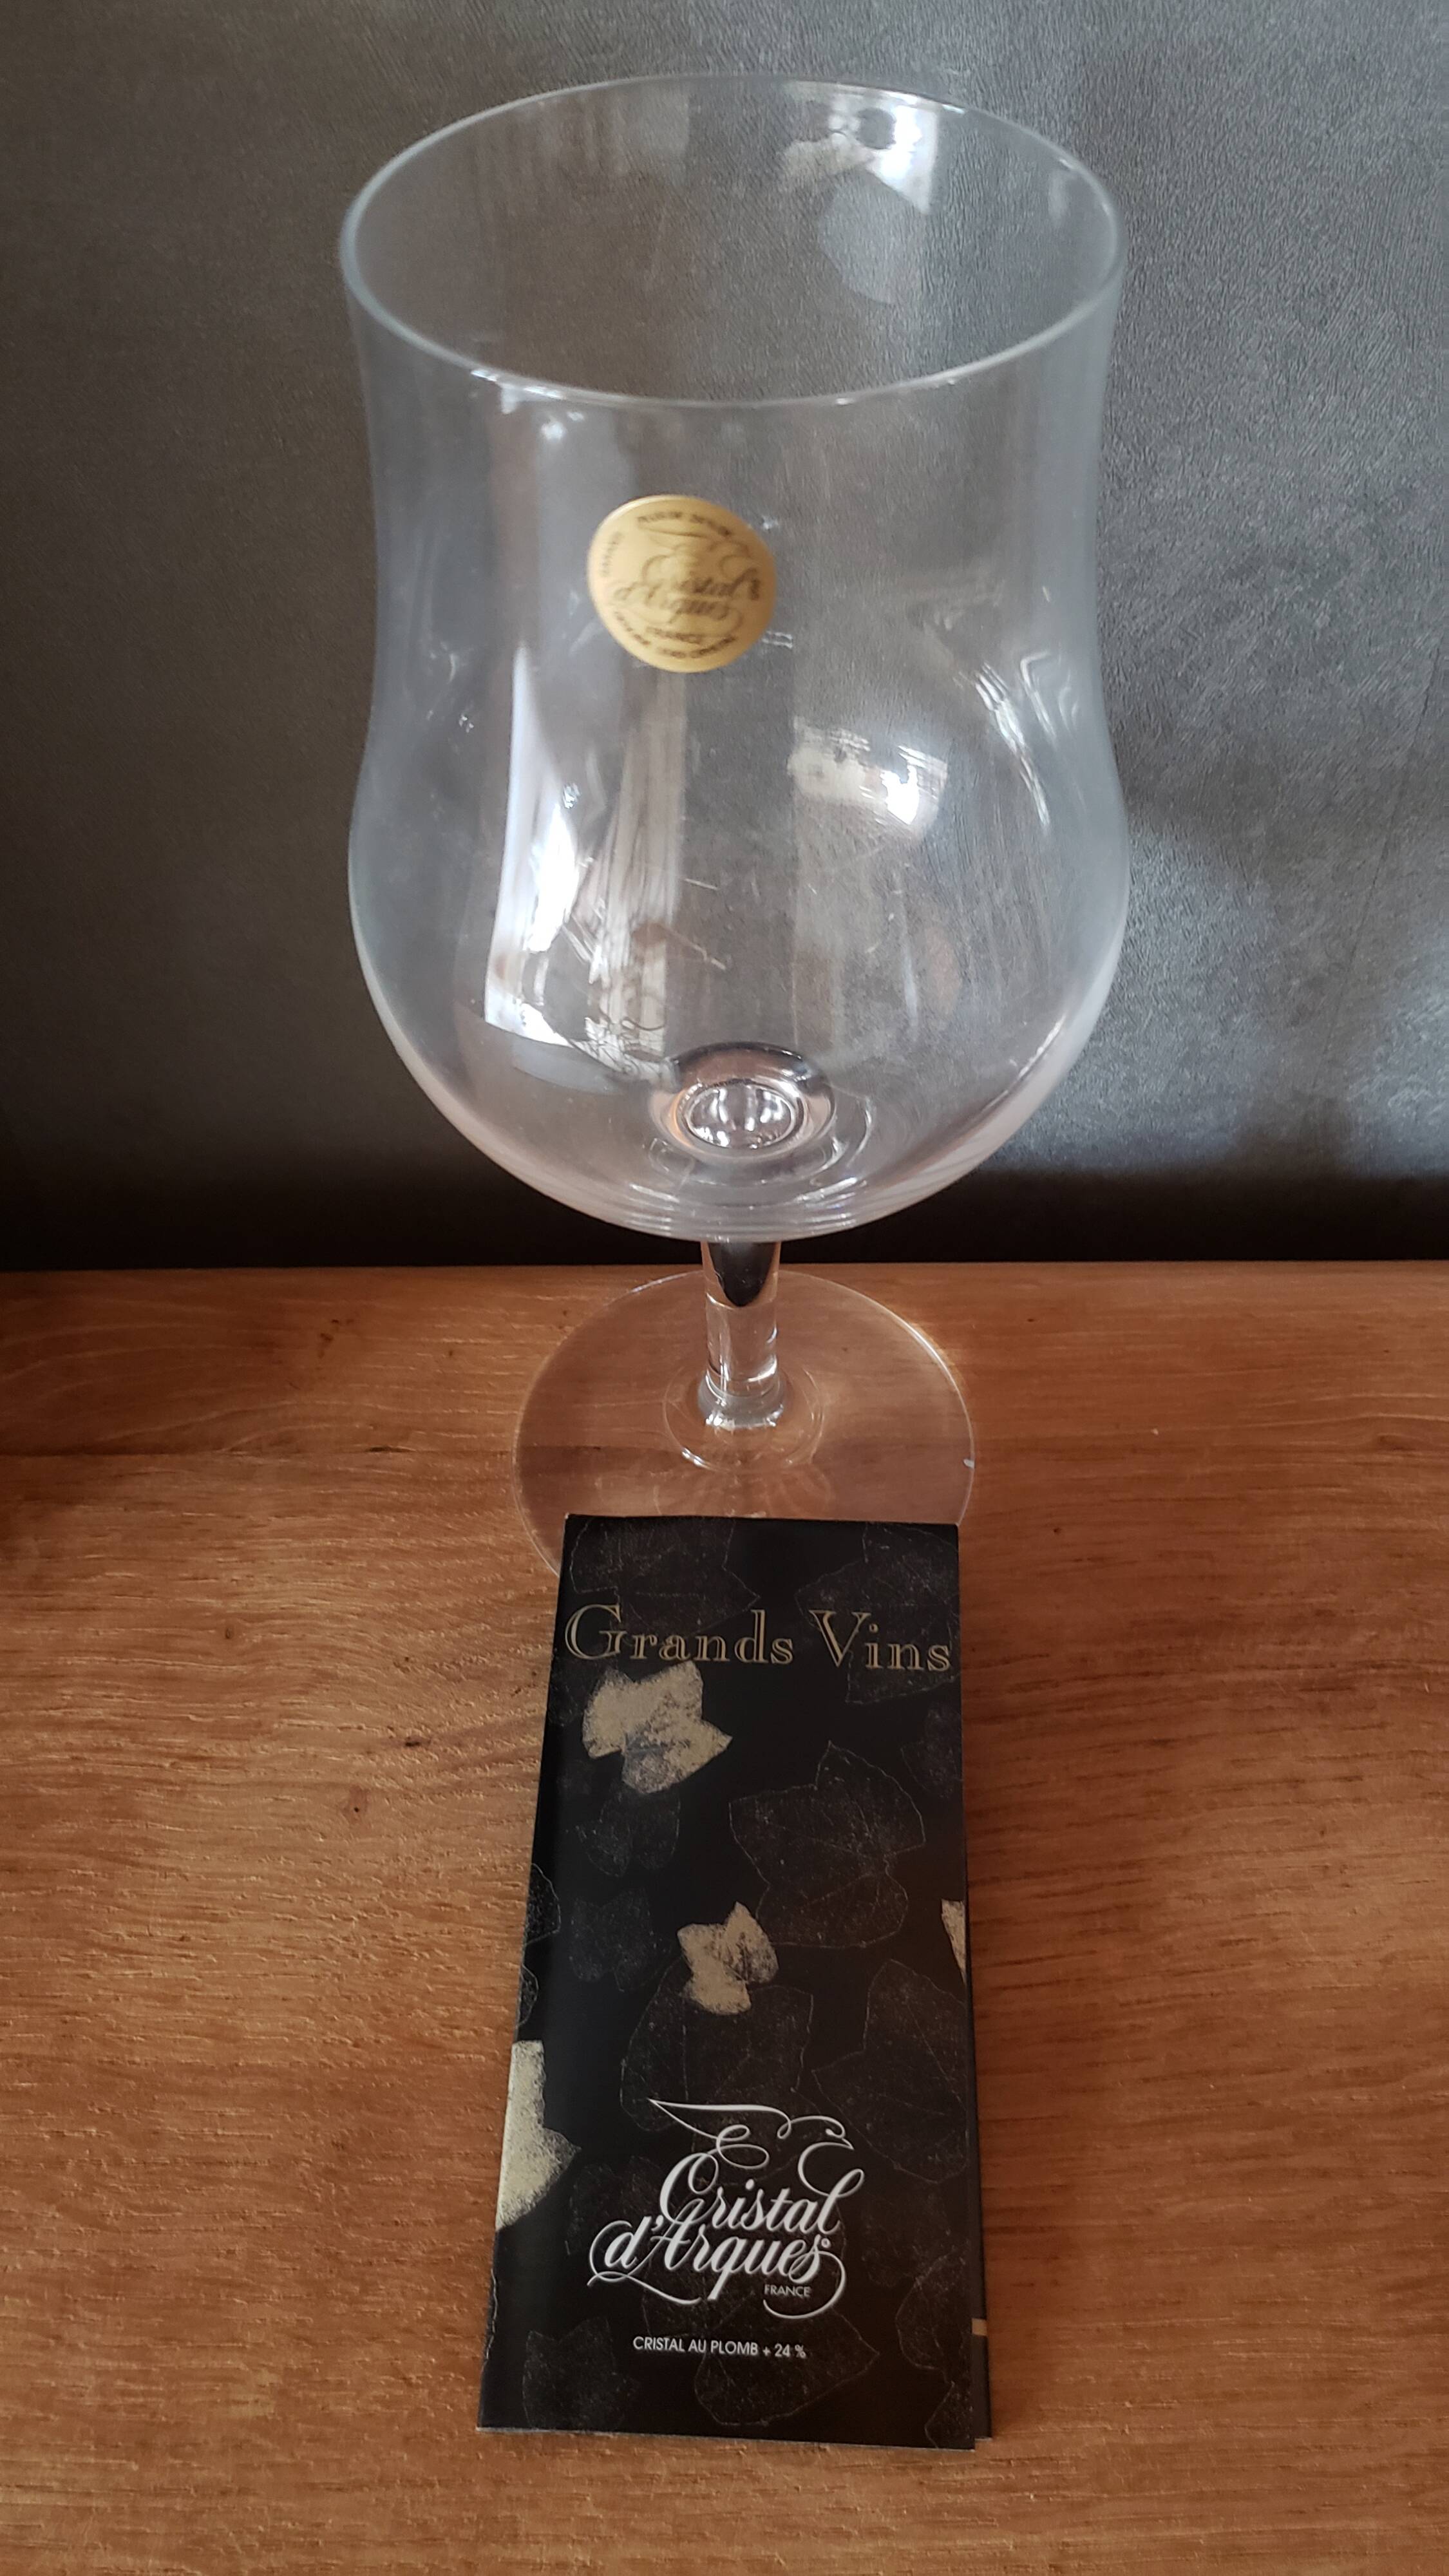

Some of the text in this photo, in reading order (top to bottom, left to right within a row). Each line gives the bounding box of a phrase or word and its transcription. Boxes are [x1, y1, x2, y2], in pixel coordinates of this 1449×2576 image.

[564, 1603, 952, 1672] Grands Vins
[654, 2119, 865, 2235] Cristal
[764, 2284, 811, 2298] FRANCE
[632, 2336, 807, 2359] CRISTAL AU PLOMB + 24 %
